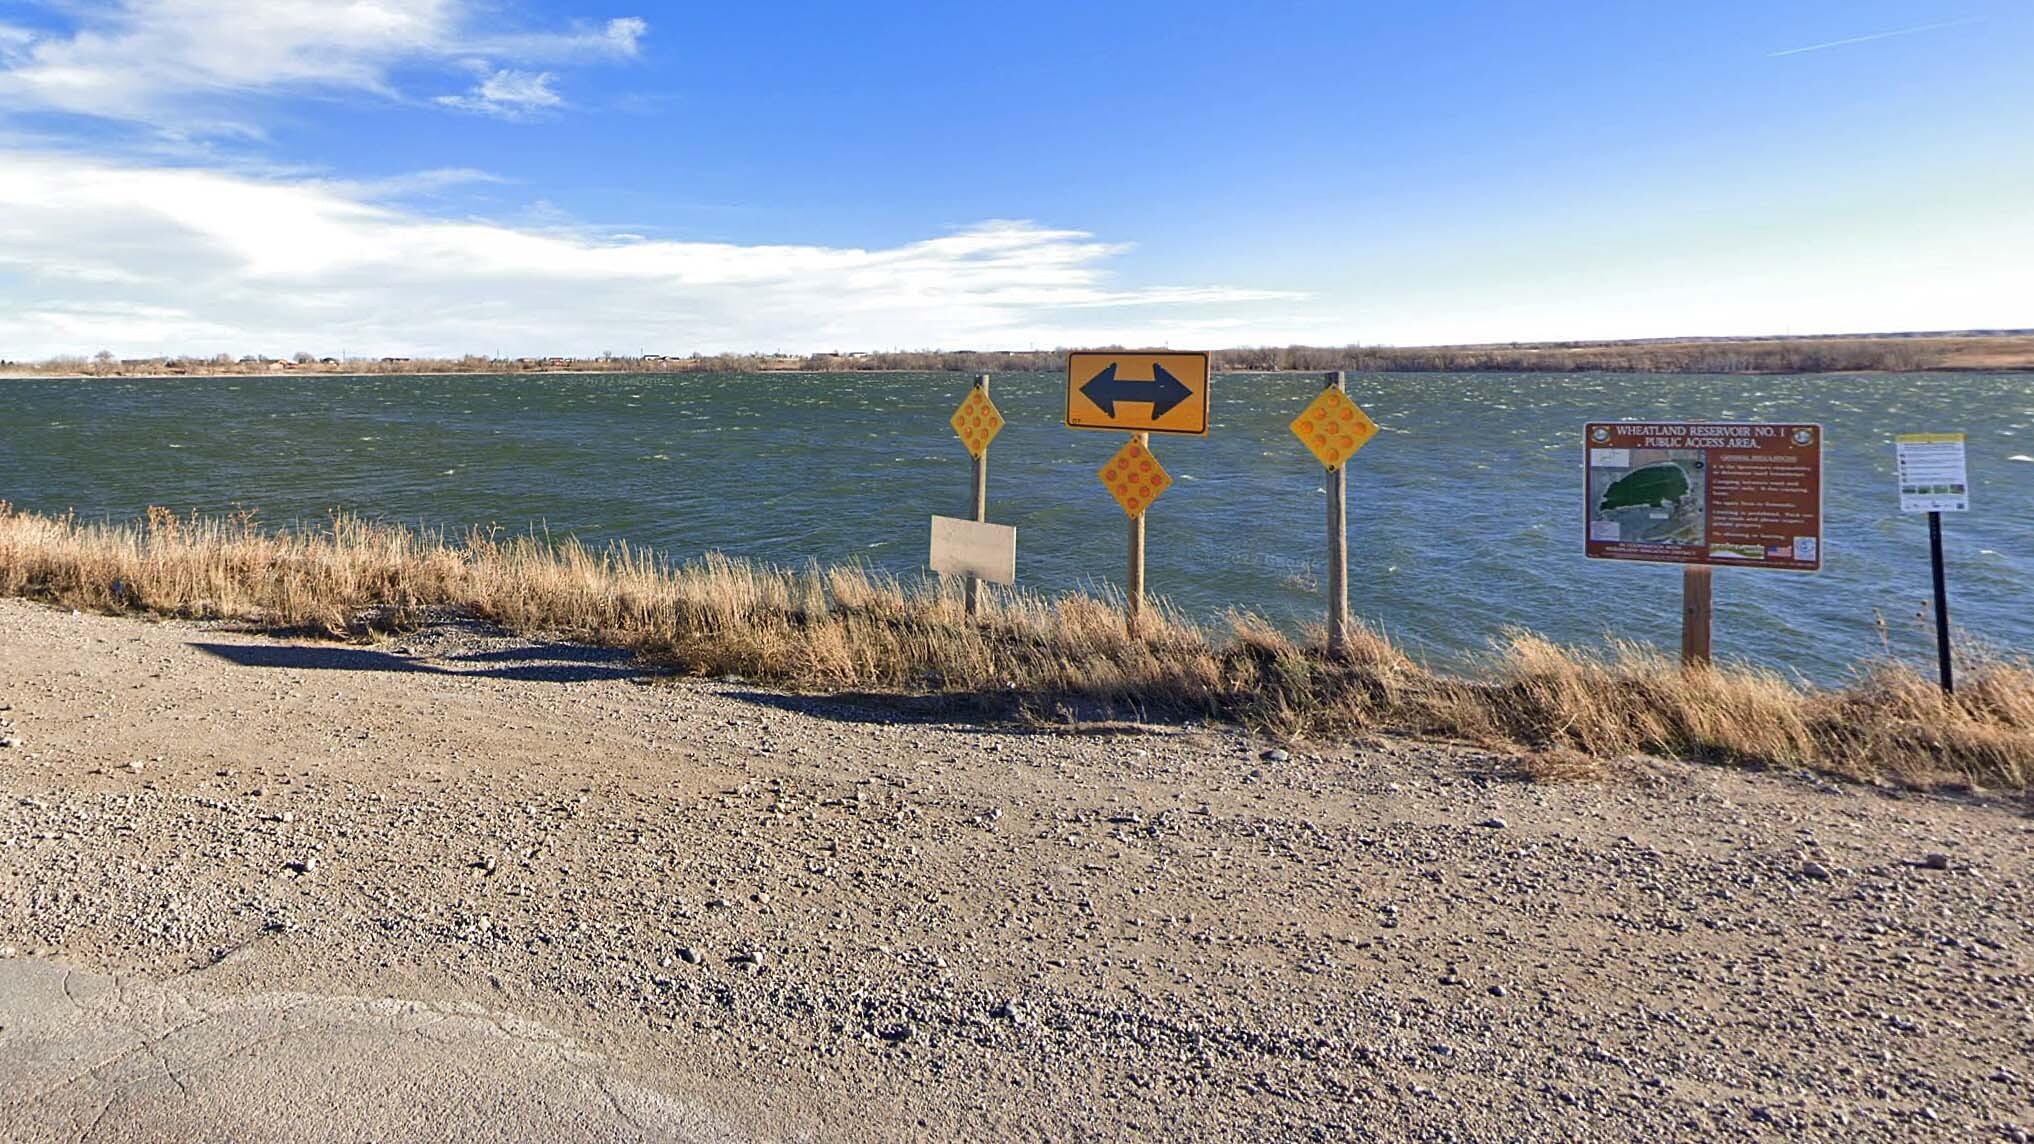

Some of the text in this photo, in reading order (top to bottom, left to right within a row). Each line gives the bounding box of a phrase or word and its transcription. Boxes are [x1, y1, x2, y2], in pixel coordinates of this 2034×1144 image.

[1616, 426, 1686, 437] WHEATLAND
[1690, 427, 1750, 437] RESERVOIR
[1754, 427, 1776, 437] NO.
[1644, 437, 1682, 447] PUBLIC
[1684, 437, 1724, 448] ACCESS
